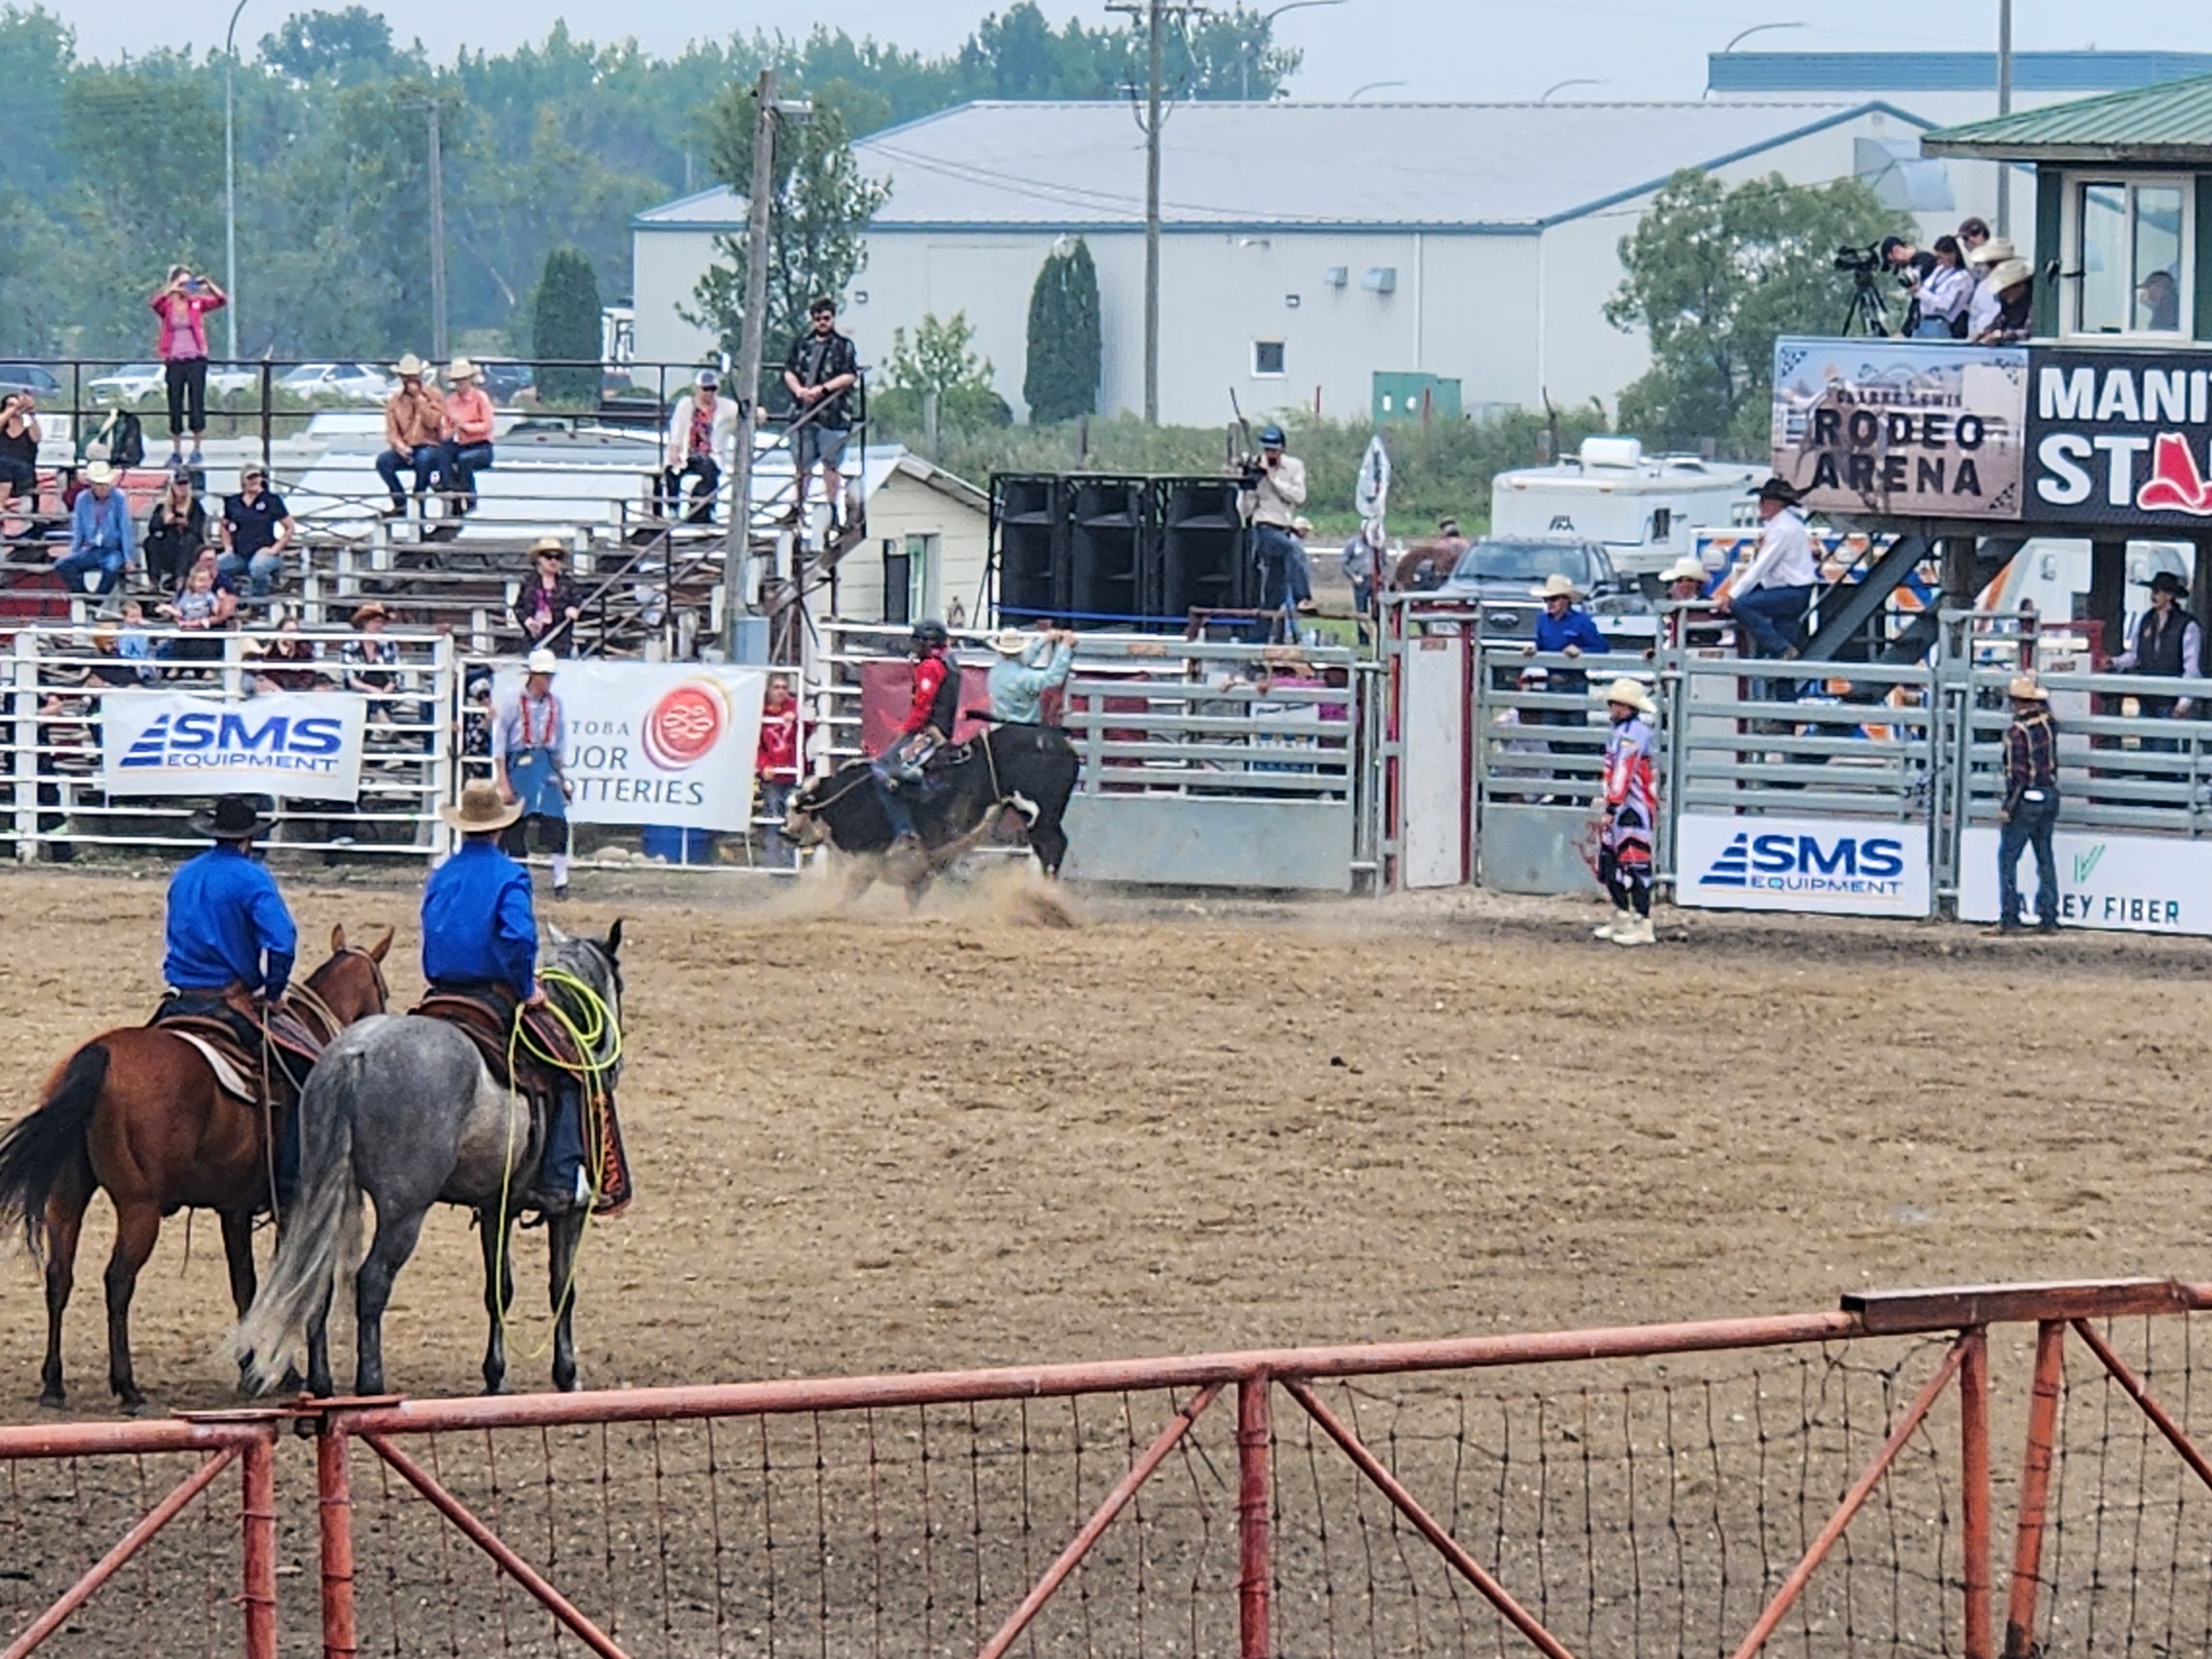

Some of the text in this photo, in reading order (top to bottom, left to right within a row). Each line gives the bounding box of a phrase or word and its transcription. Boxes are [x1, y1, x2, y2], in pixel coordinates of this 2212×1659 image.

[2039, 367, 2212, 422] MANI
[1815, 409, 1984, 450] RODEO
[1812, 452, 1982, 496] ARENA
[170, 712, 342, 754] SMS
[168, 753, 338, 772] EQUIPMENT
[1752, 834, 1903, 877] SMS
[1750, 876, 1903, 895] EQUIPMENT
[2104, 896, 2179, 925] FIBER
